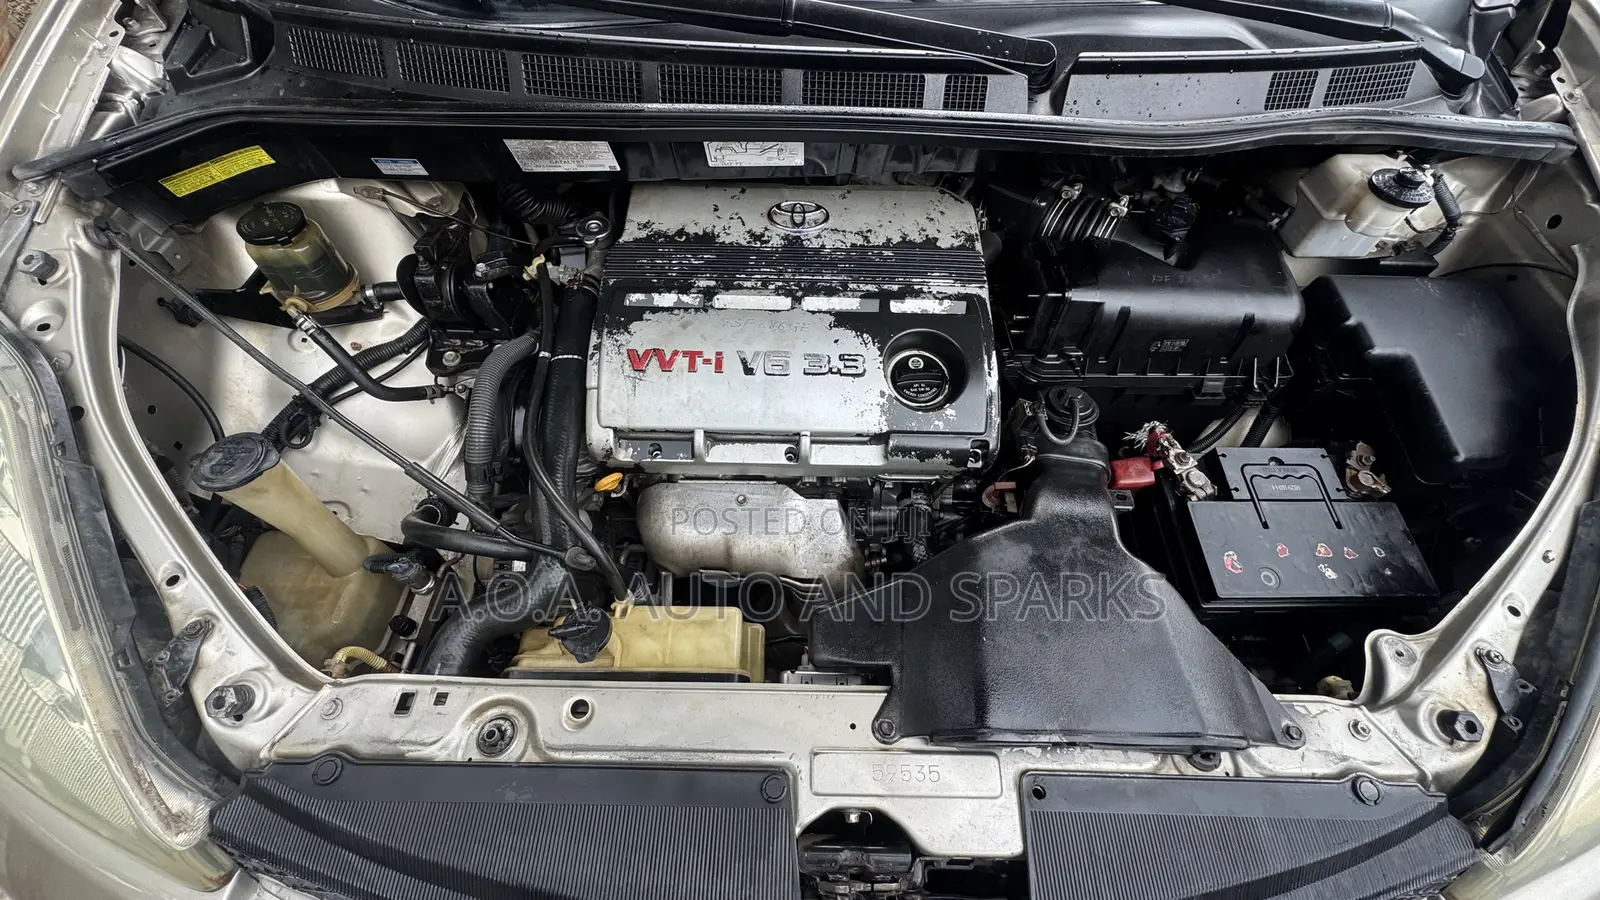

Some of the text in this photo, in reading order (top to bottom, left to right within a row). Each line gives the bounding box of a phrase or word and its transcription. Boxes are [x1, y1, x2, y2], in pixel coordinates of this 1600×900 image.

[626, 348, 867, 377] VVT-i V6 3.3
[872, 763, 941, 783] 59535
